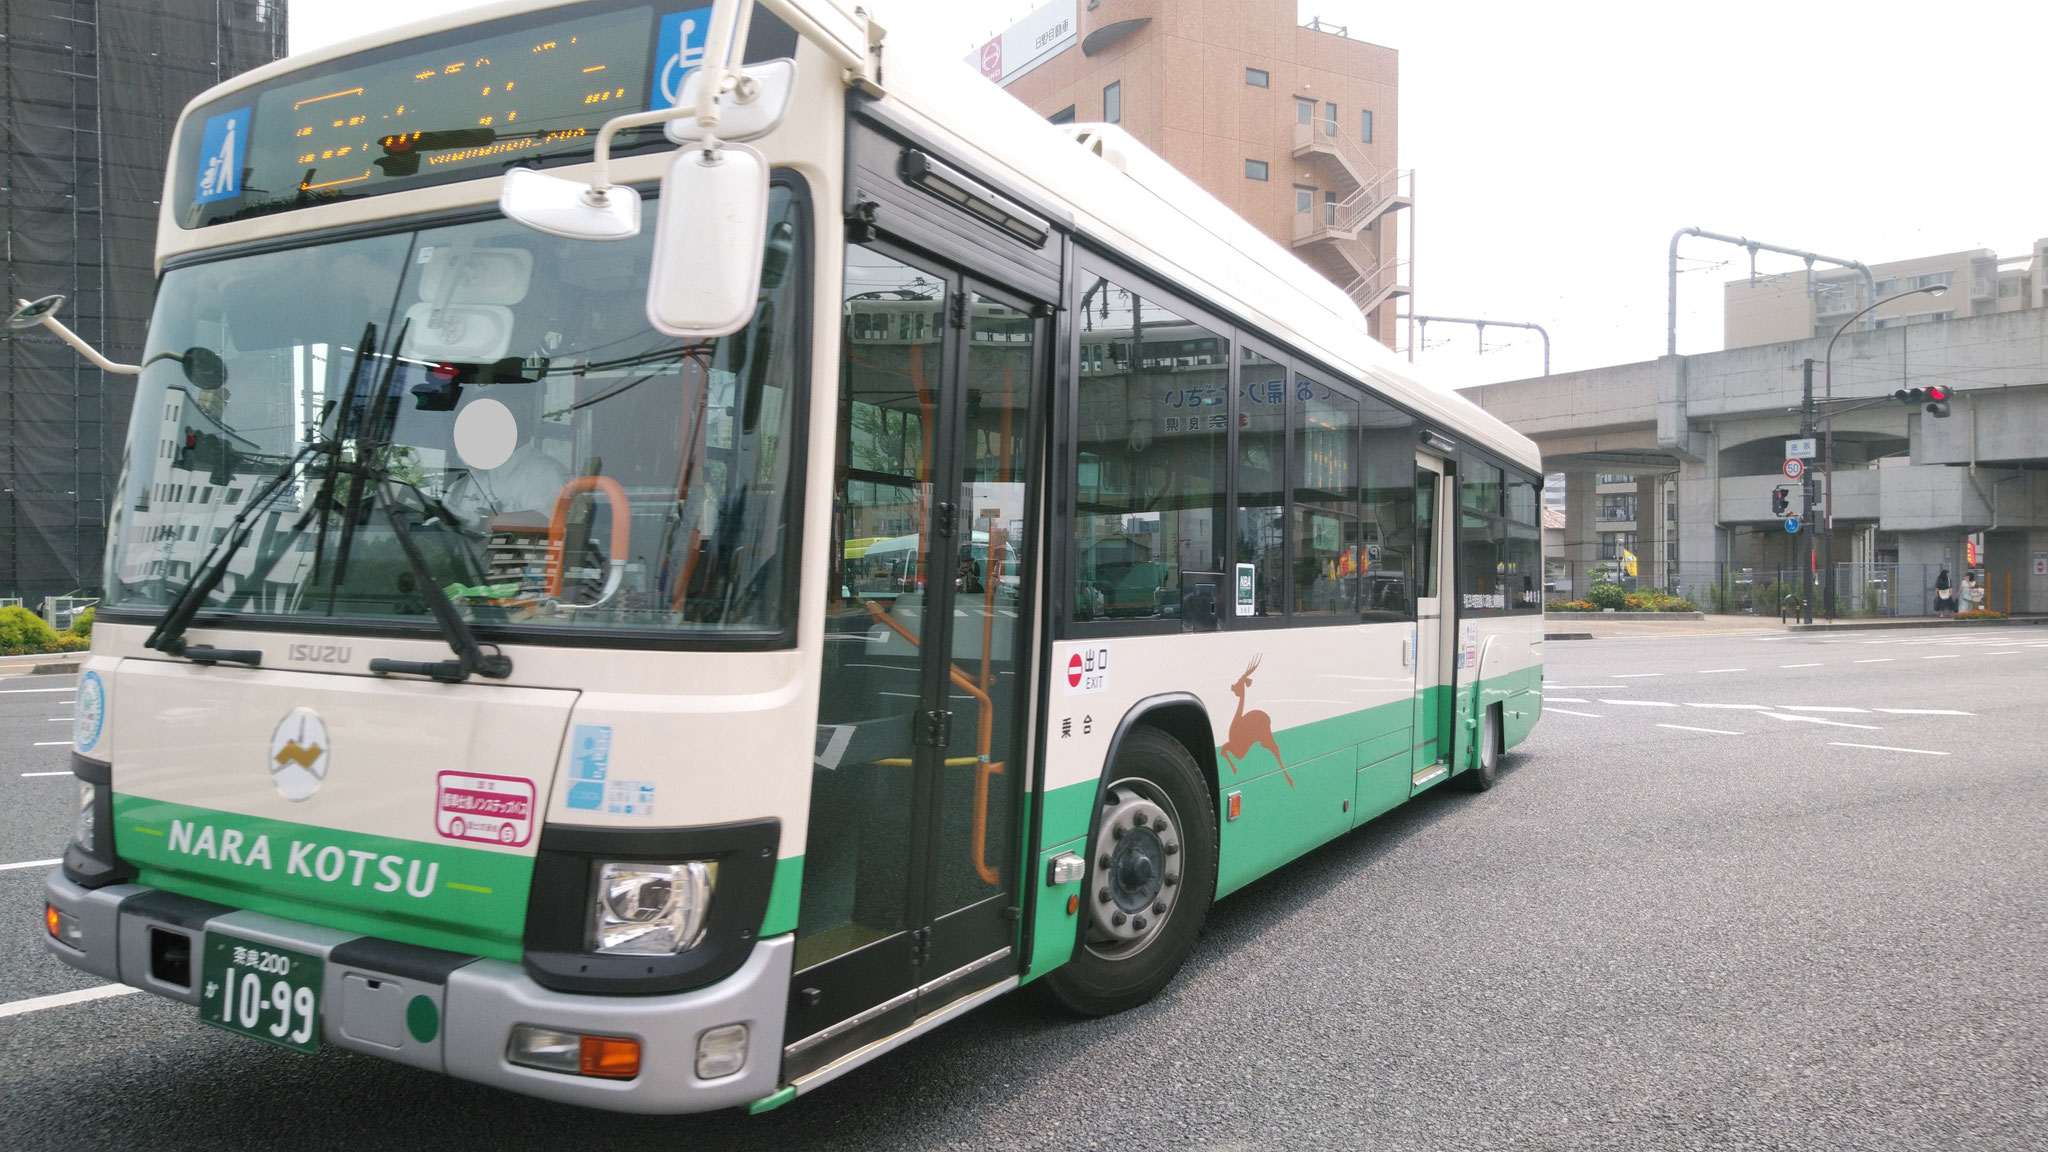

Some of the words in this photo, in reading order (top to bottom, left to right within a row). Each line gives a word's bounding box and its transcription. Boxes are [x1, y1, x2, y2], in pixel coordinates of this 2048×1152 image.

[1035, 18, 1069, 50] 日野自動車
[1787, 463, 1799, 474] 50
[289, 644, 352, 664] ISUZU
[1084, 648, 1108, 672] 出口
[1086, 676, 1103, 690] EXIT
[168, 820, 272, 870] NARA
[286, 841, 439, 898] KOTSU
[222, 967, 315, 1044] 10-99
